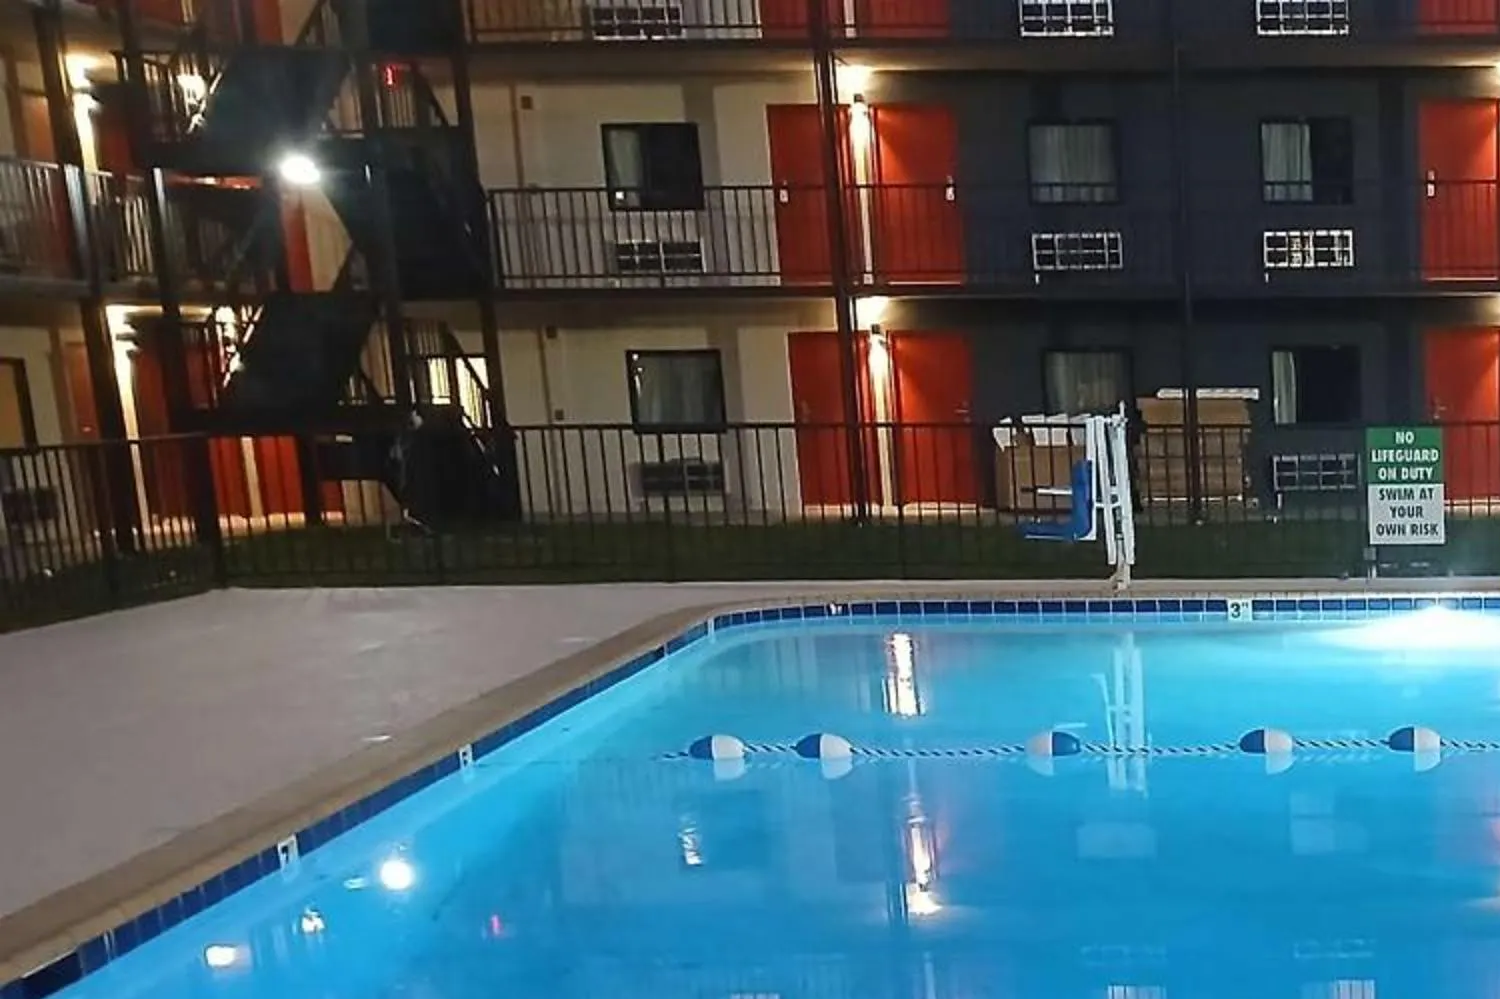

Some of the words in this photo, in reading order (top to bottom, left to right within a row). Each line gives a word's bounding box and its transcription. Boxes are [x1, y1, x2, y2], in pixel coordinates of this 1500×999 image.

[1395, 431, 1415, 444] NO
[1371, 449, 1439, 462] LIFEGUARD
[1378, 467, 1397, 480] ON
[1401, 467, 1433, 480] DUTY
[1379, 487, 1415, 501] SWIM
[1420, 487, 1434, 500] AT
[1389, 506, 1424, 518] YOUR
[1376, 523, 1406, 536] OWN
[1411, 523, 1439, 536] RISK
